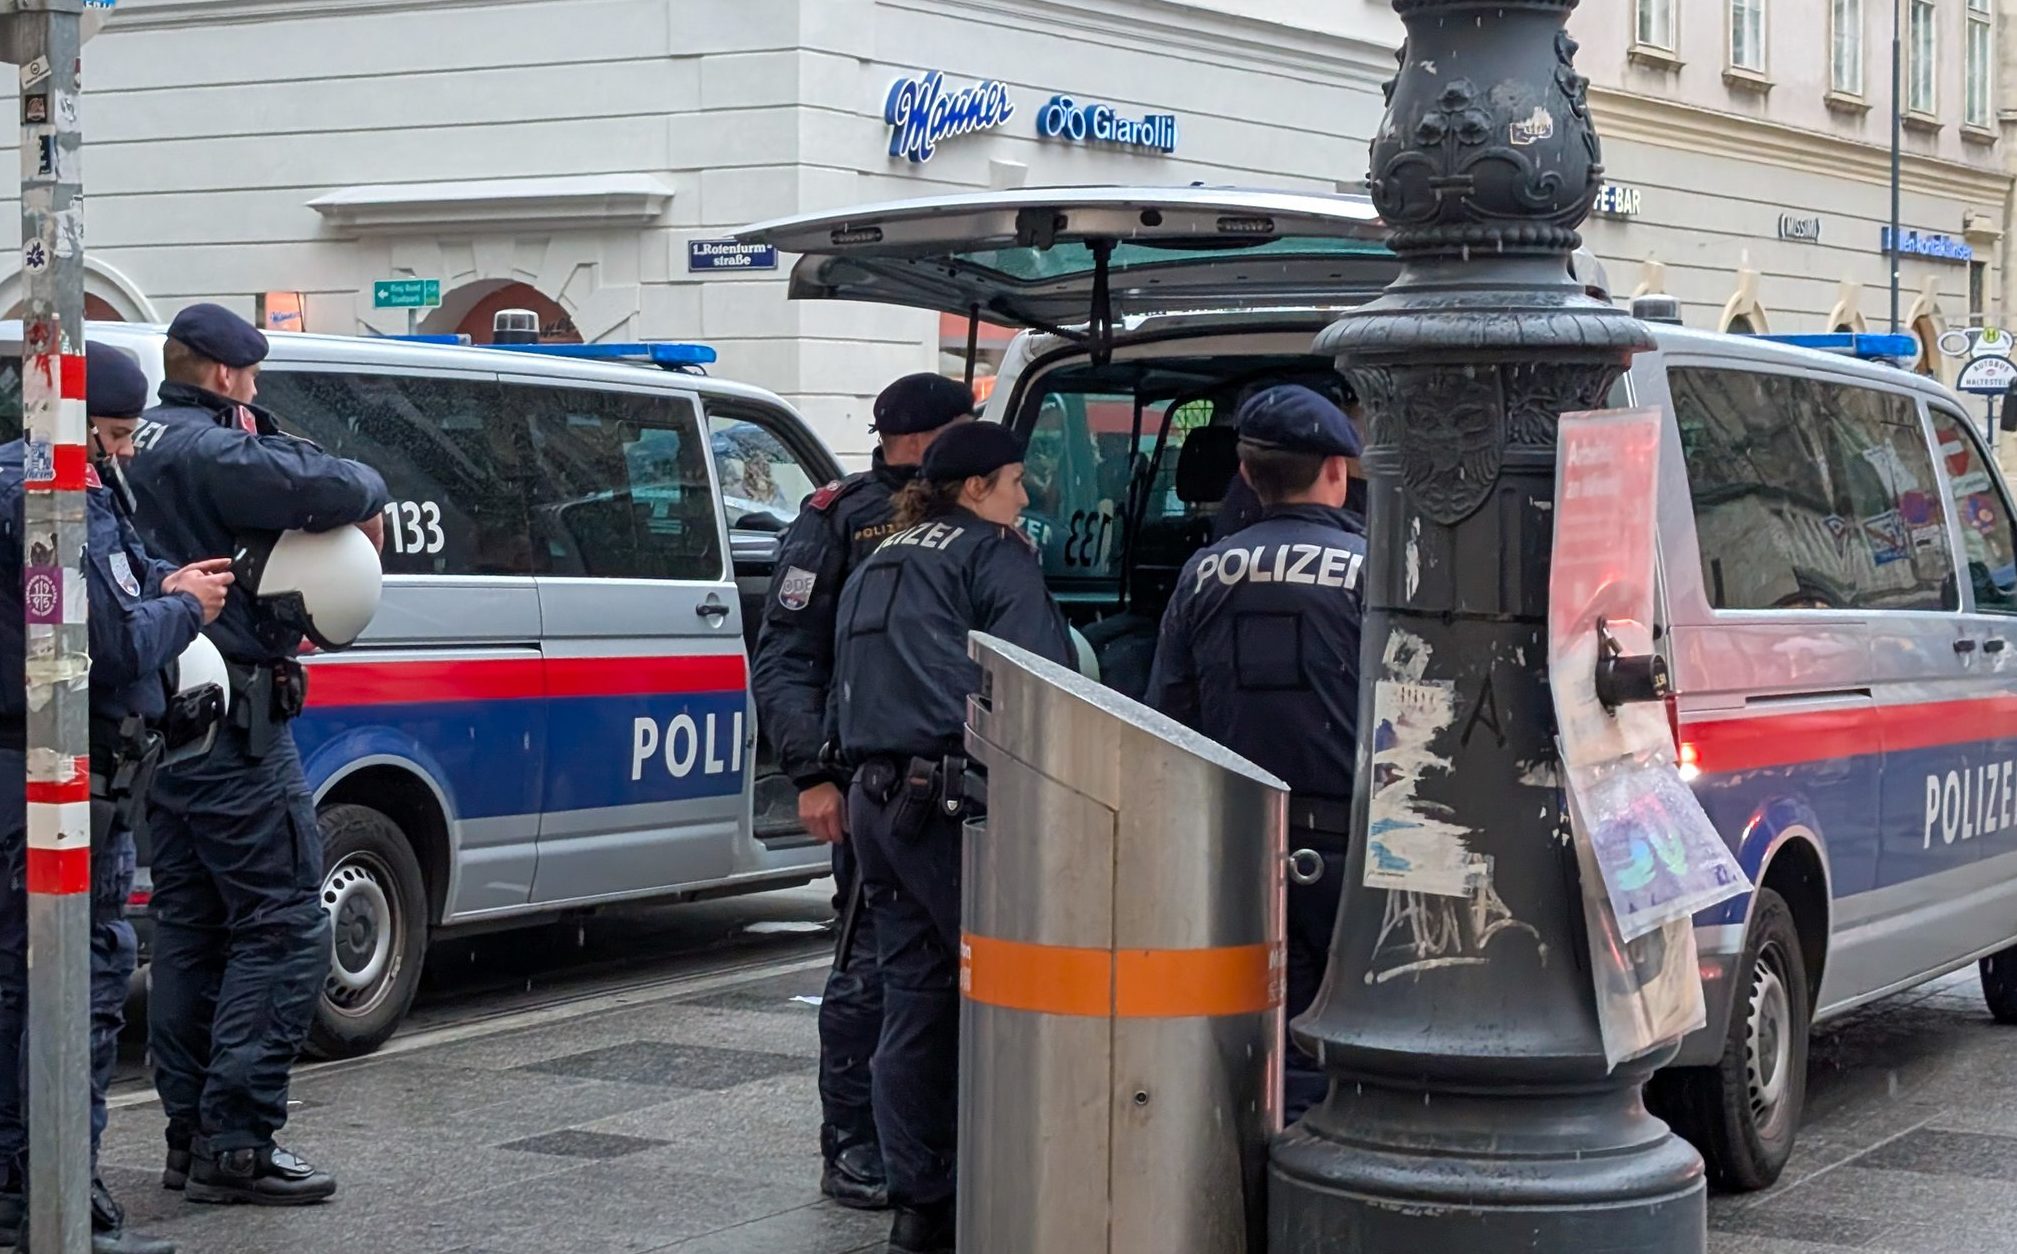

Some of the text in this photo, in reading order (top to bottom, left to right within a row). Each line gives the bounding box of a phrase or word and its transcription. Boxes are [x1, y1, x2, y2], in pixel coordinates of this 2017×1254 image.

[889, 70, 1015, 163] Manner
[1093, 105, 1176, 149] Giarolli
[713, 254, 752, 266] straße
[1986, 329, 1997, 341] H
[1973, 359, 2011, 373] AUTOBUS
[1965, 378, 2009, 386] HALTESTEL
[385, 500, 445, 553] 133
[854, 523, 898, 541] POLIZ
[1193, 543, 1364, 594] POLIZEI
[631, 711, 743, 781] POLI
